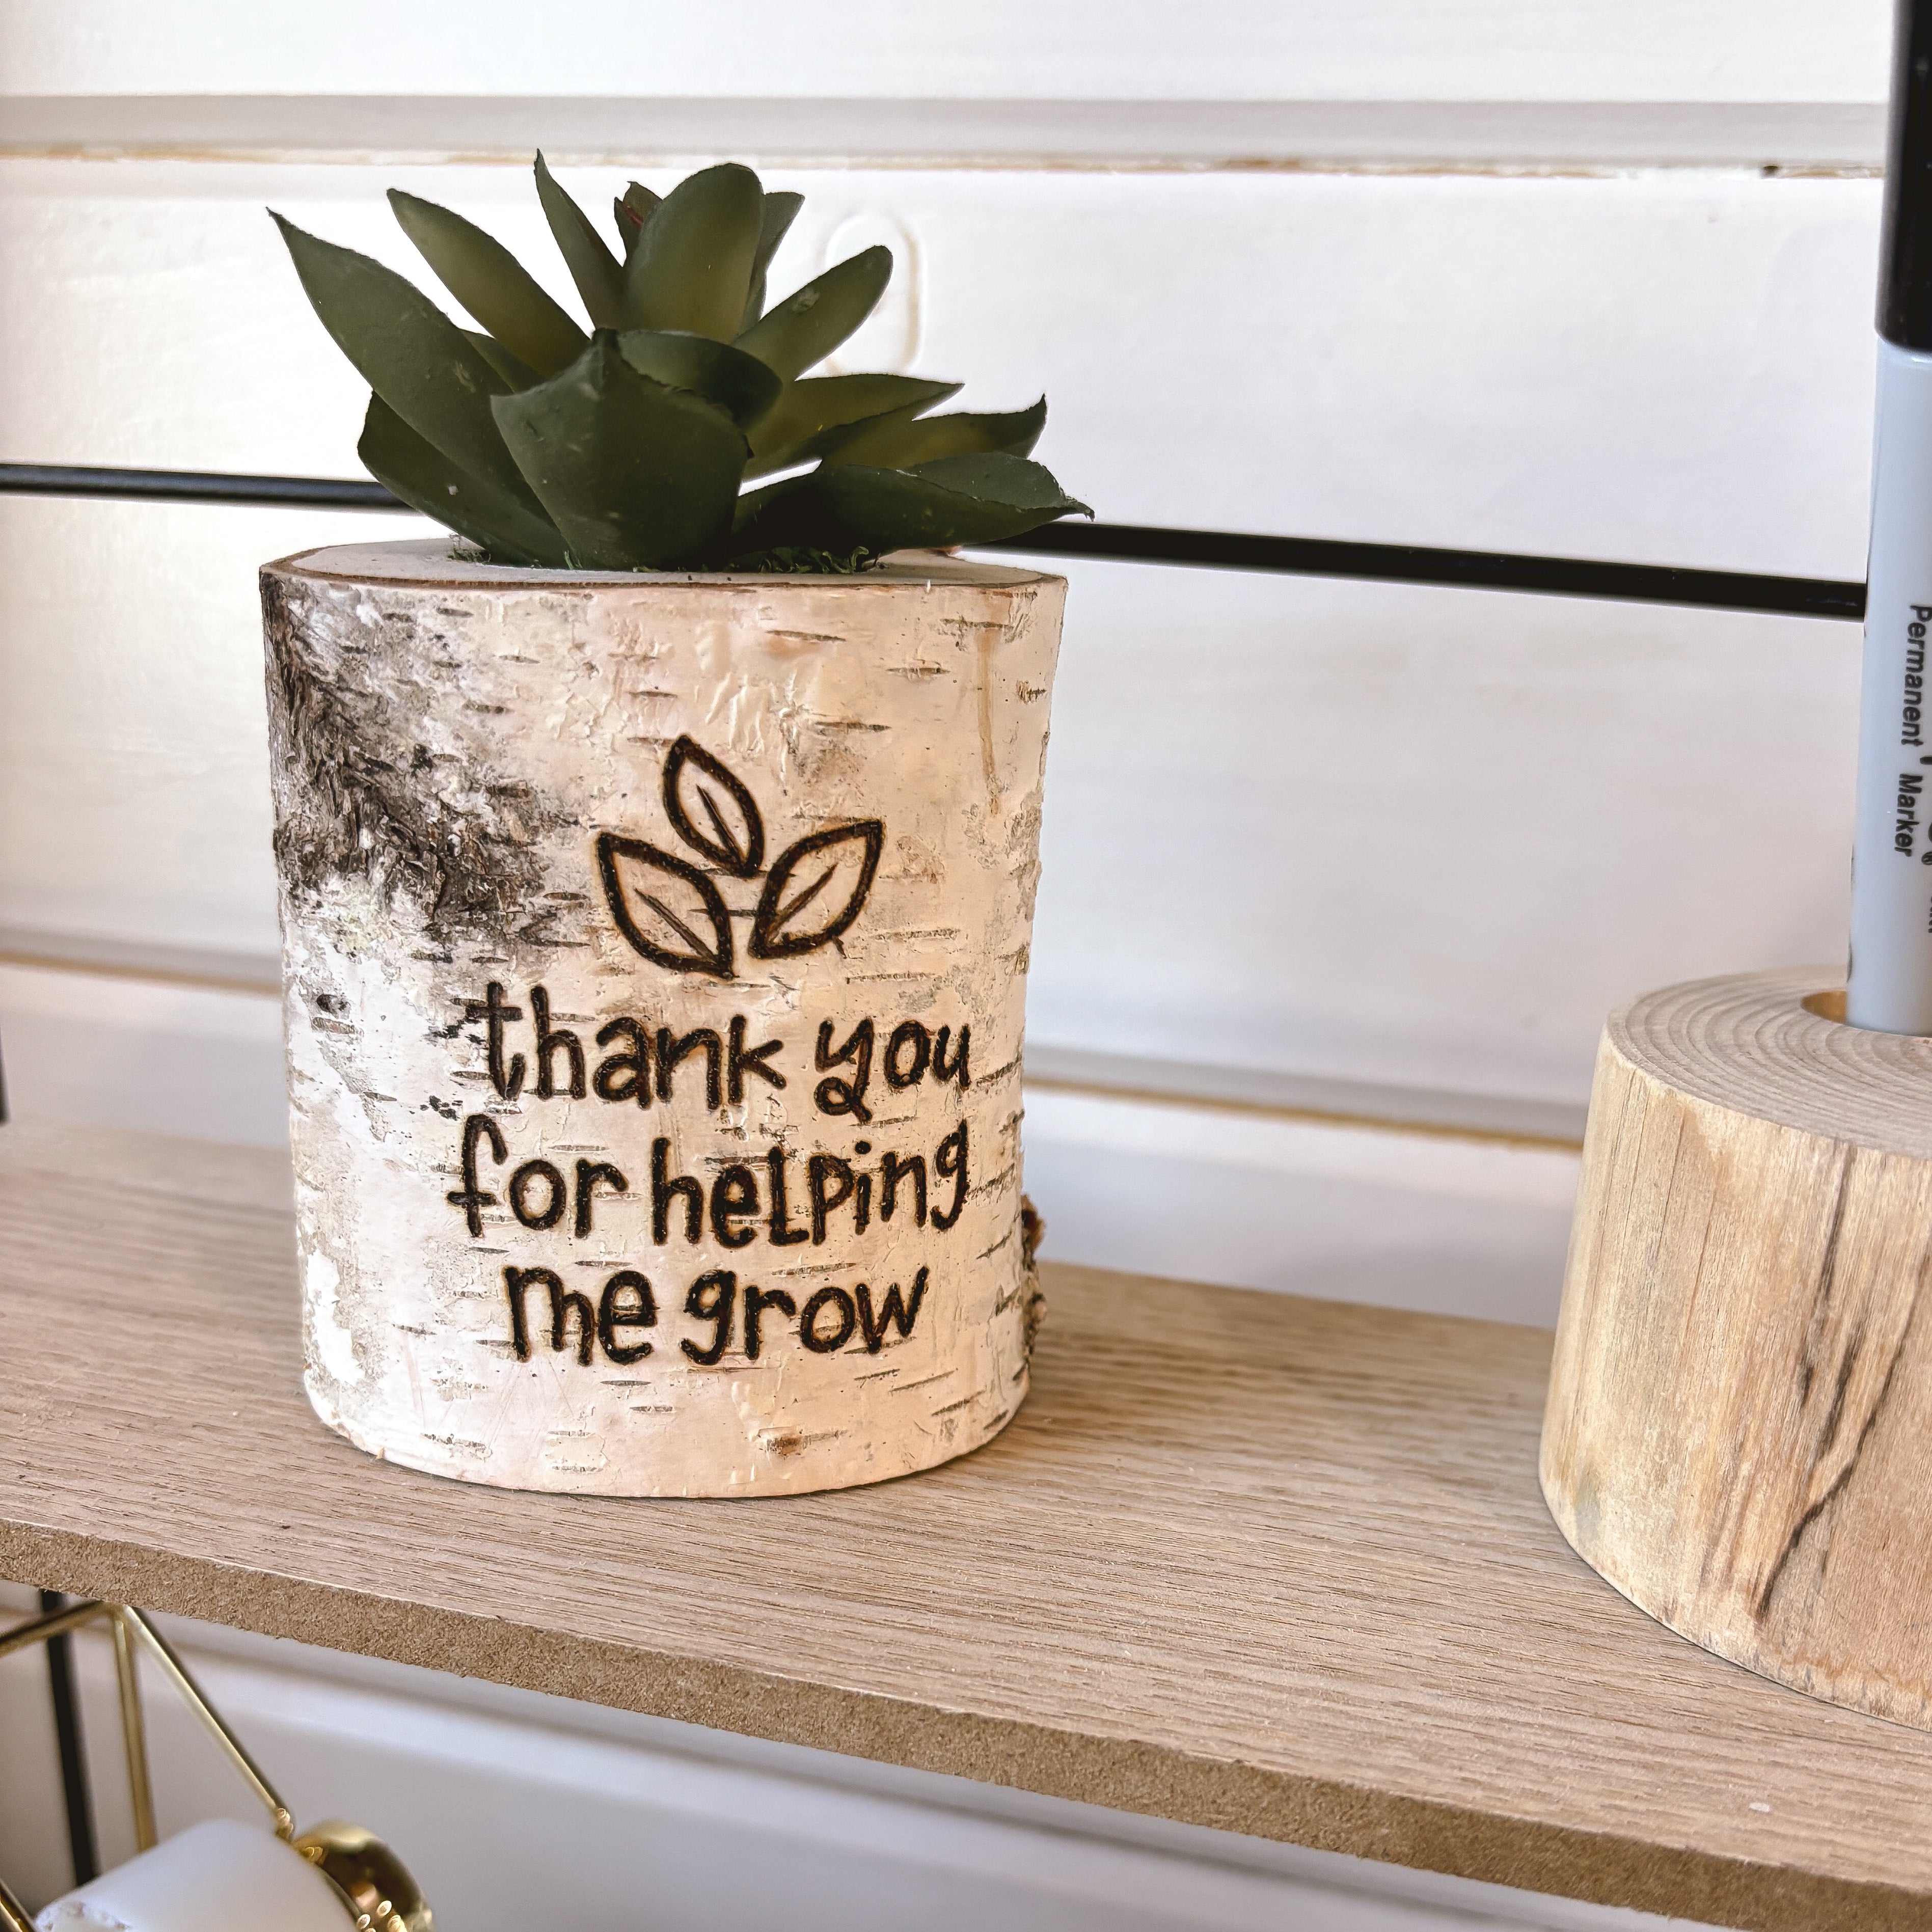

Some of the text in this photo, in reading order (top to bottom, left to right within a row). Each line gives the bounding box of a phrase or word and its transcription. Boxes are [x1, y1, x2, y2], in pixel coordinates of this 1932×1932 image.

[1900, 604, 1932, 746] Permanent
[1894, 773, 1924, 857] Marker
[465, 981, 972, 1121] thank you
[446, 1114, 629, 1238] for
[503, 1266, 931, 1366] me grow
